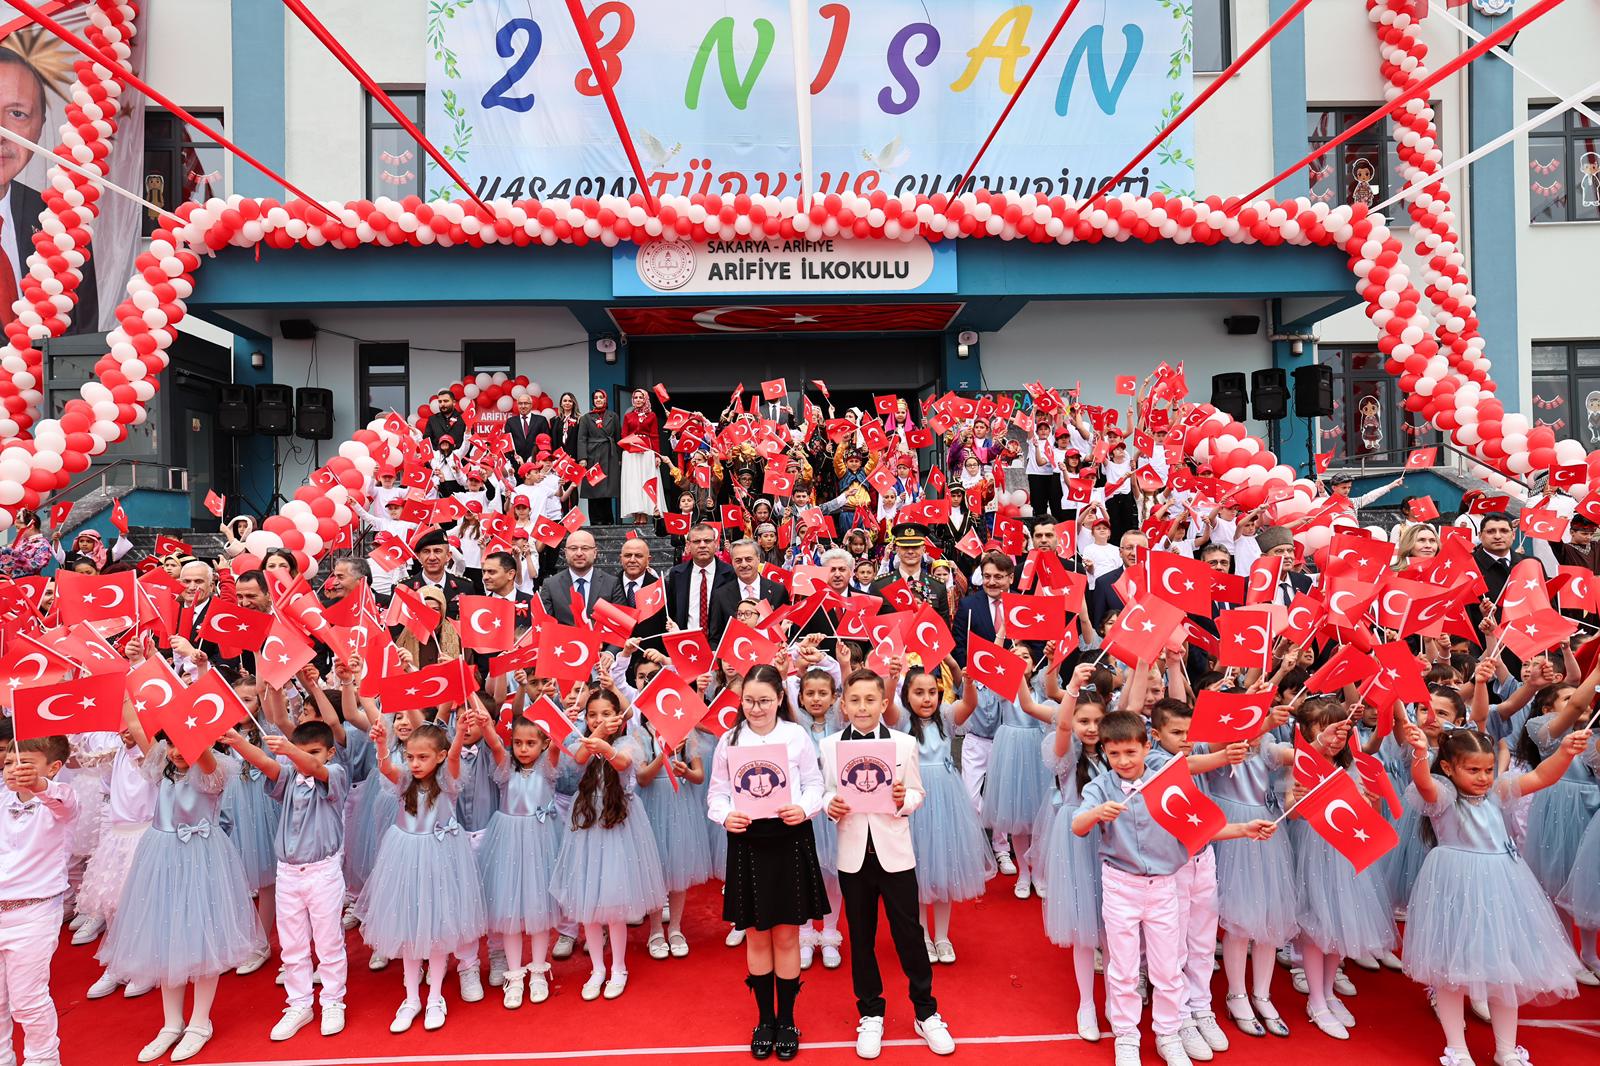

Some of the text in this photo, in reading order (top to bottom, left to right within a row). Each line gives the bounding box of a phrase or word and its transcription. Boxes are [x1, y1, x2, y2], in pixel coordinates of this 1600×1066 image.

[481, 1, 635, 112] 23
[707, 239, 771, 254] SAKARYA
[708, 257, 791, 281] ARİFİYE
[801, 256, 910, 280] İLKOKULU
